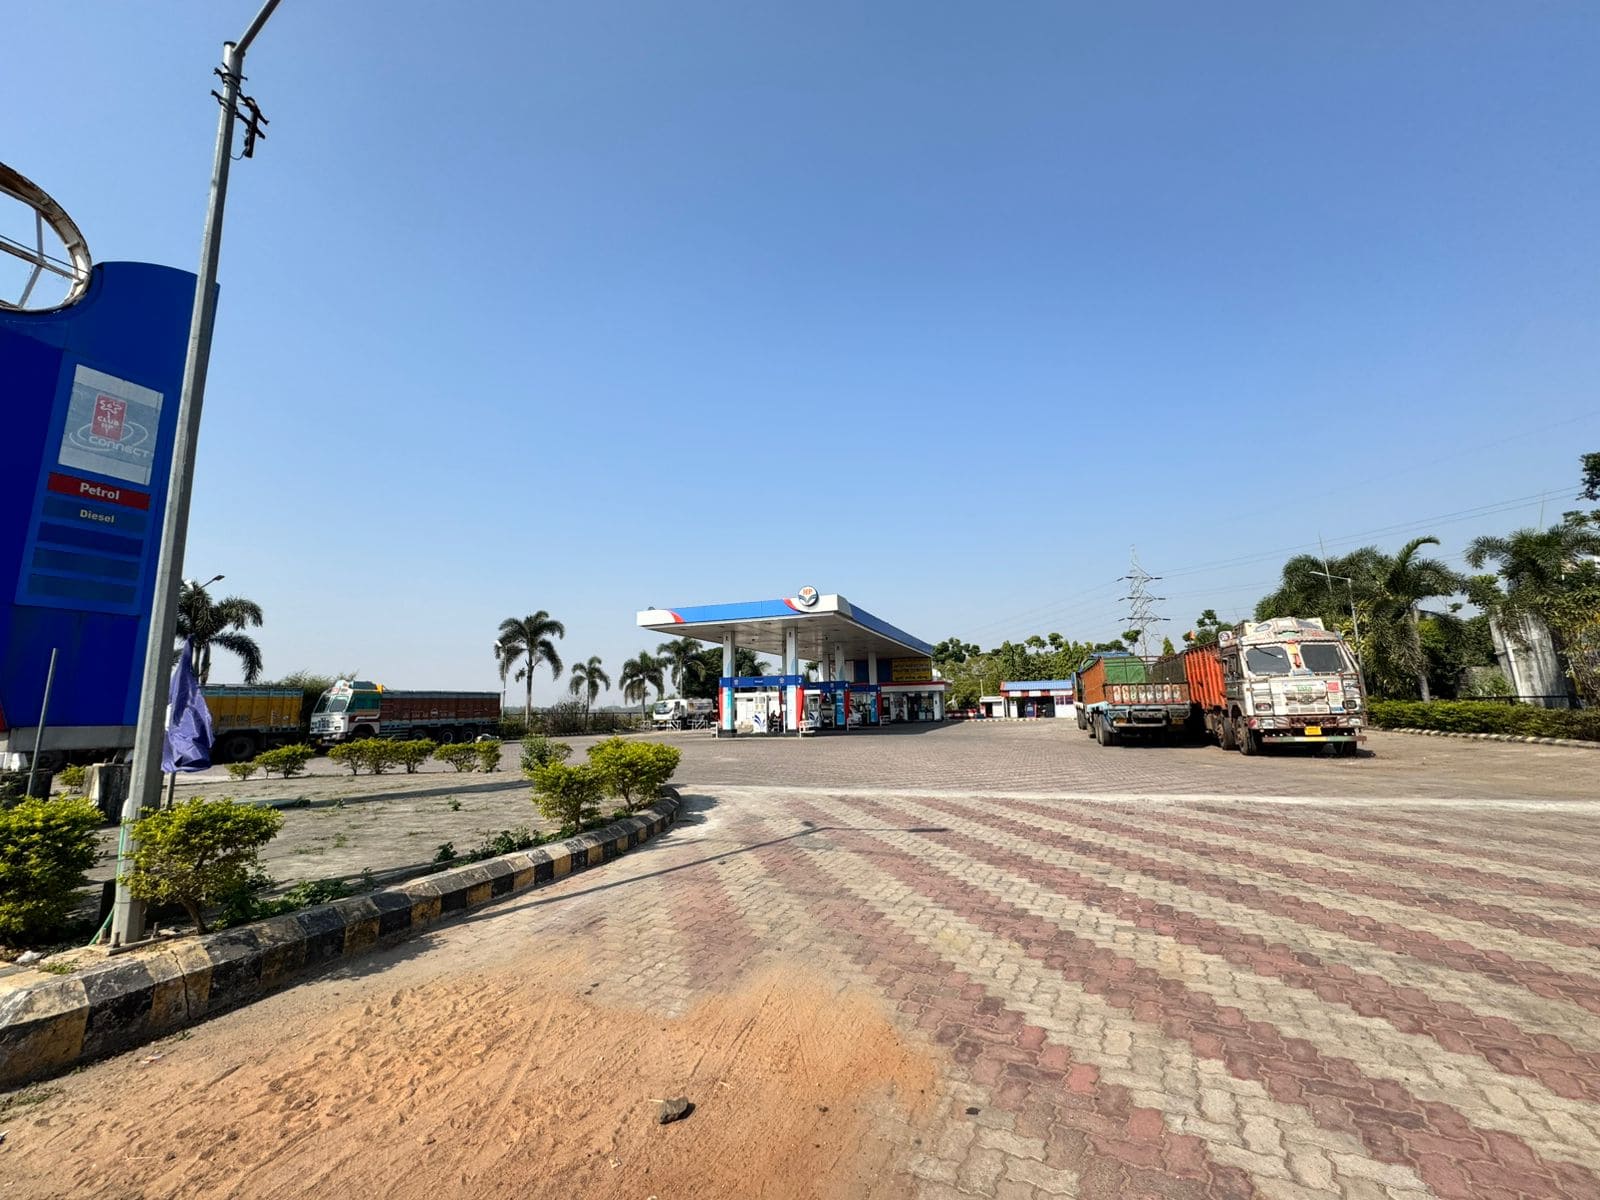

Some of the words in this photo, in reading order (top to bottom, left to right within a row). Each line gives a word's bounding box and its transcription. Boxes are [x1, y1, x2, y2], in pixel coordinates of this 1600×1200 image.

[80, 482, 120, 500] Petrol
[80, 509, 115, 523] Diesel
[802, 588, 813, 596] HP
